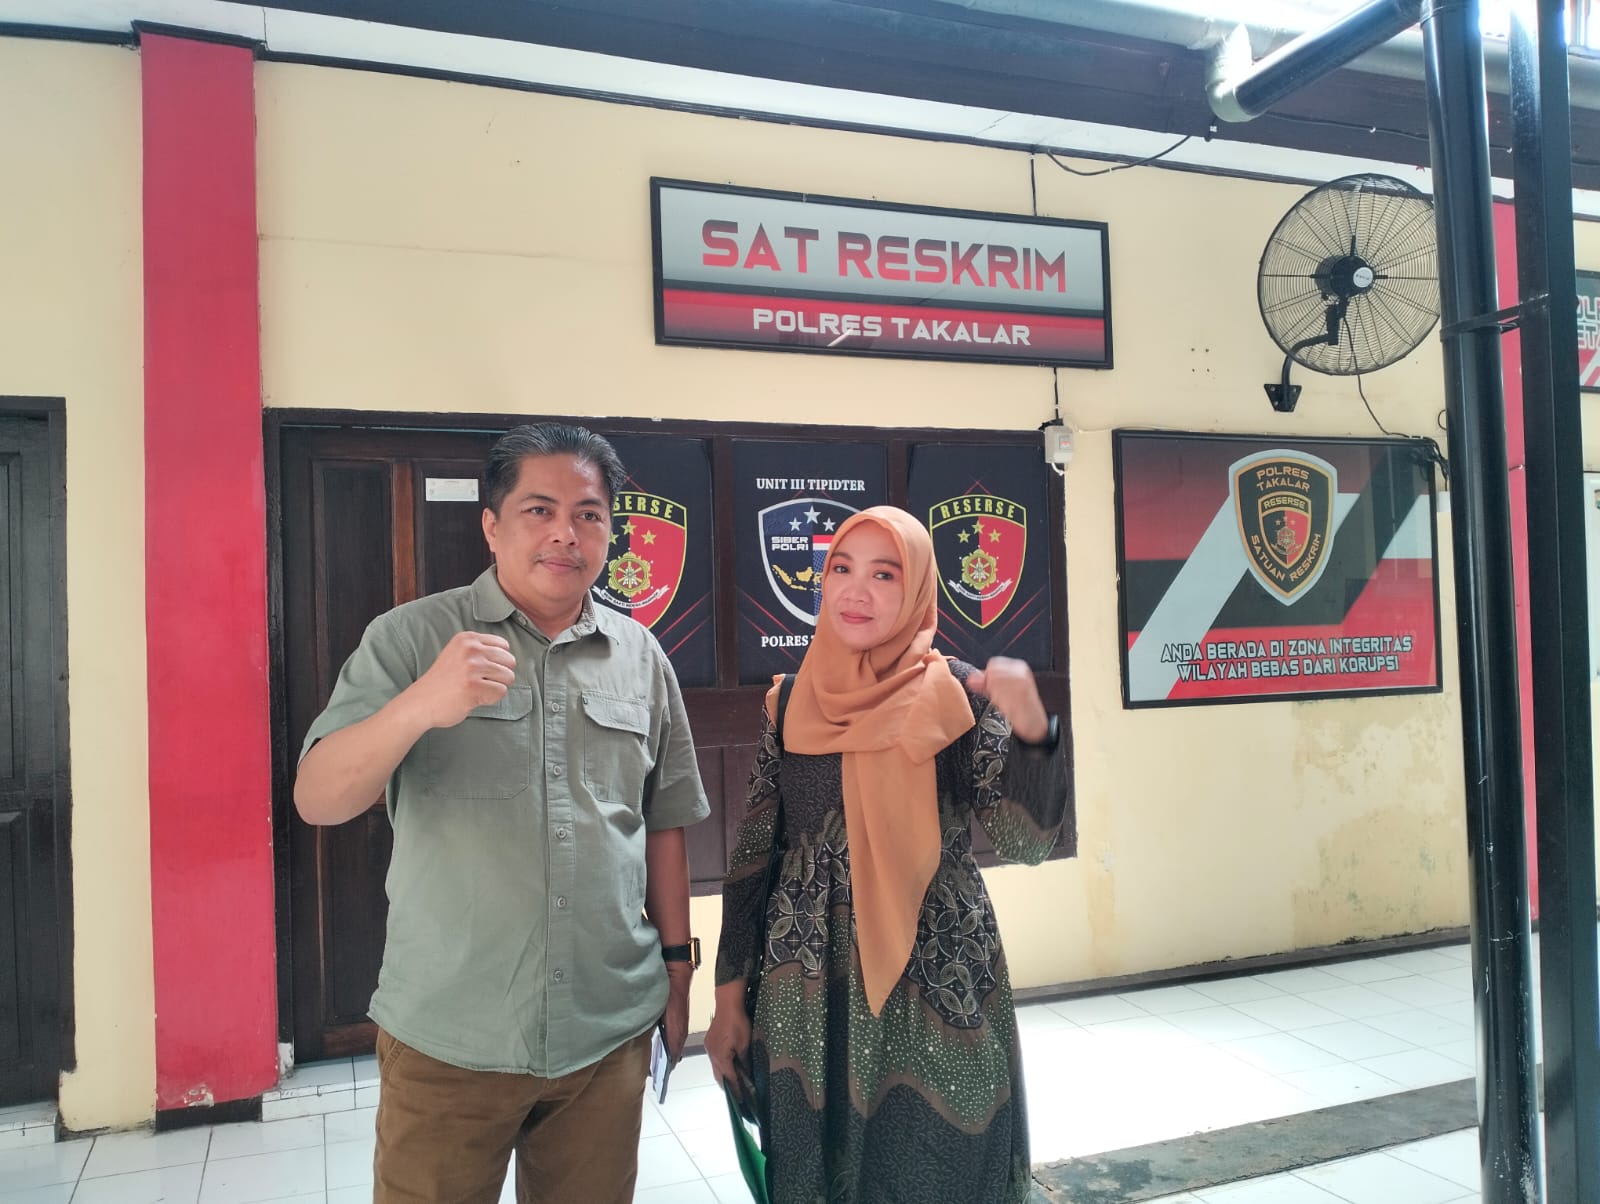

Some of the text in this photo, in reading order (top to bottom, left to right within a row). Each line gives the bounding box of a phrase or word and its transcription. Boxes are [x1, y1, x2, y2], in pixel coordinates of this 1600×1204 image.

[702, 219, 1066, 293] SAT RESKRIM
[753, 308, 1031, 346] POLRES TAKALAR
[1256, 466, 1310, 480] POLRES
[756, 478, 866, 492] UNIT III TIPIDTER
[1256, 477, 1311, 492] TAKALAR
[613, 495, 673, 519] SERSE
[940, 498, 1015, 519] RESERSE
[1263, 497, 1306, 509] RESERSE
[771, 543, 809, 551] POLRI
[1251, 533, 1321, 582] SATUAN RESKRIM
[761, 635, 809, 647] POLRES
[1161, 635, 1412, 663] ANDA BERADA DI ZONA INTEGRITAS
[1177, 654, 1400, 682] WILAYAH BEBAS DARI KORUPSI
